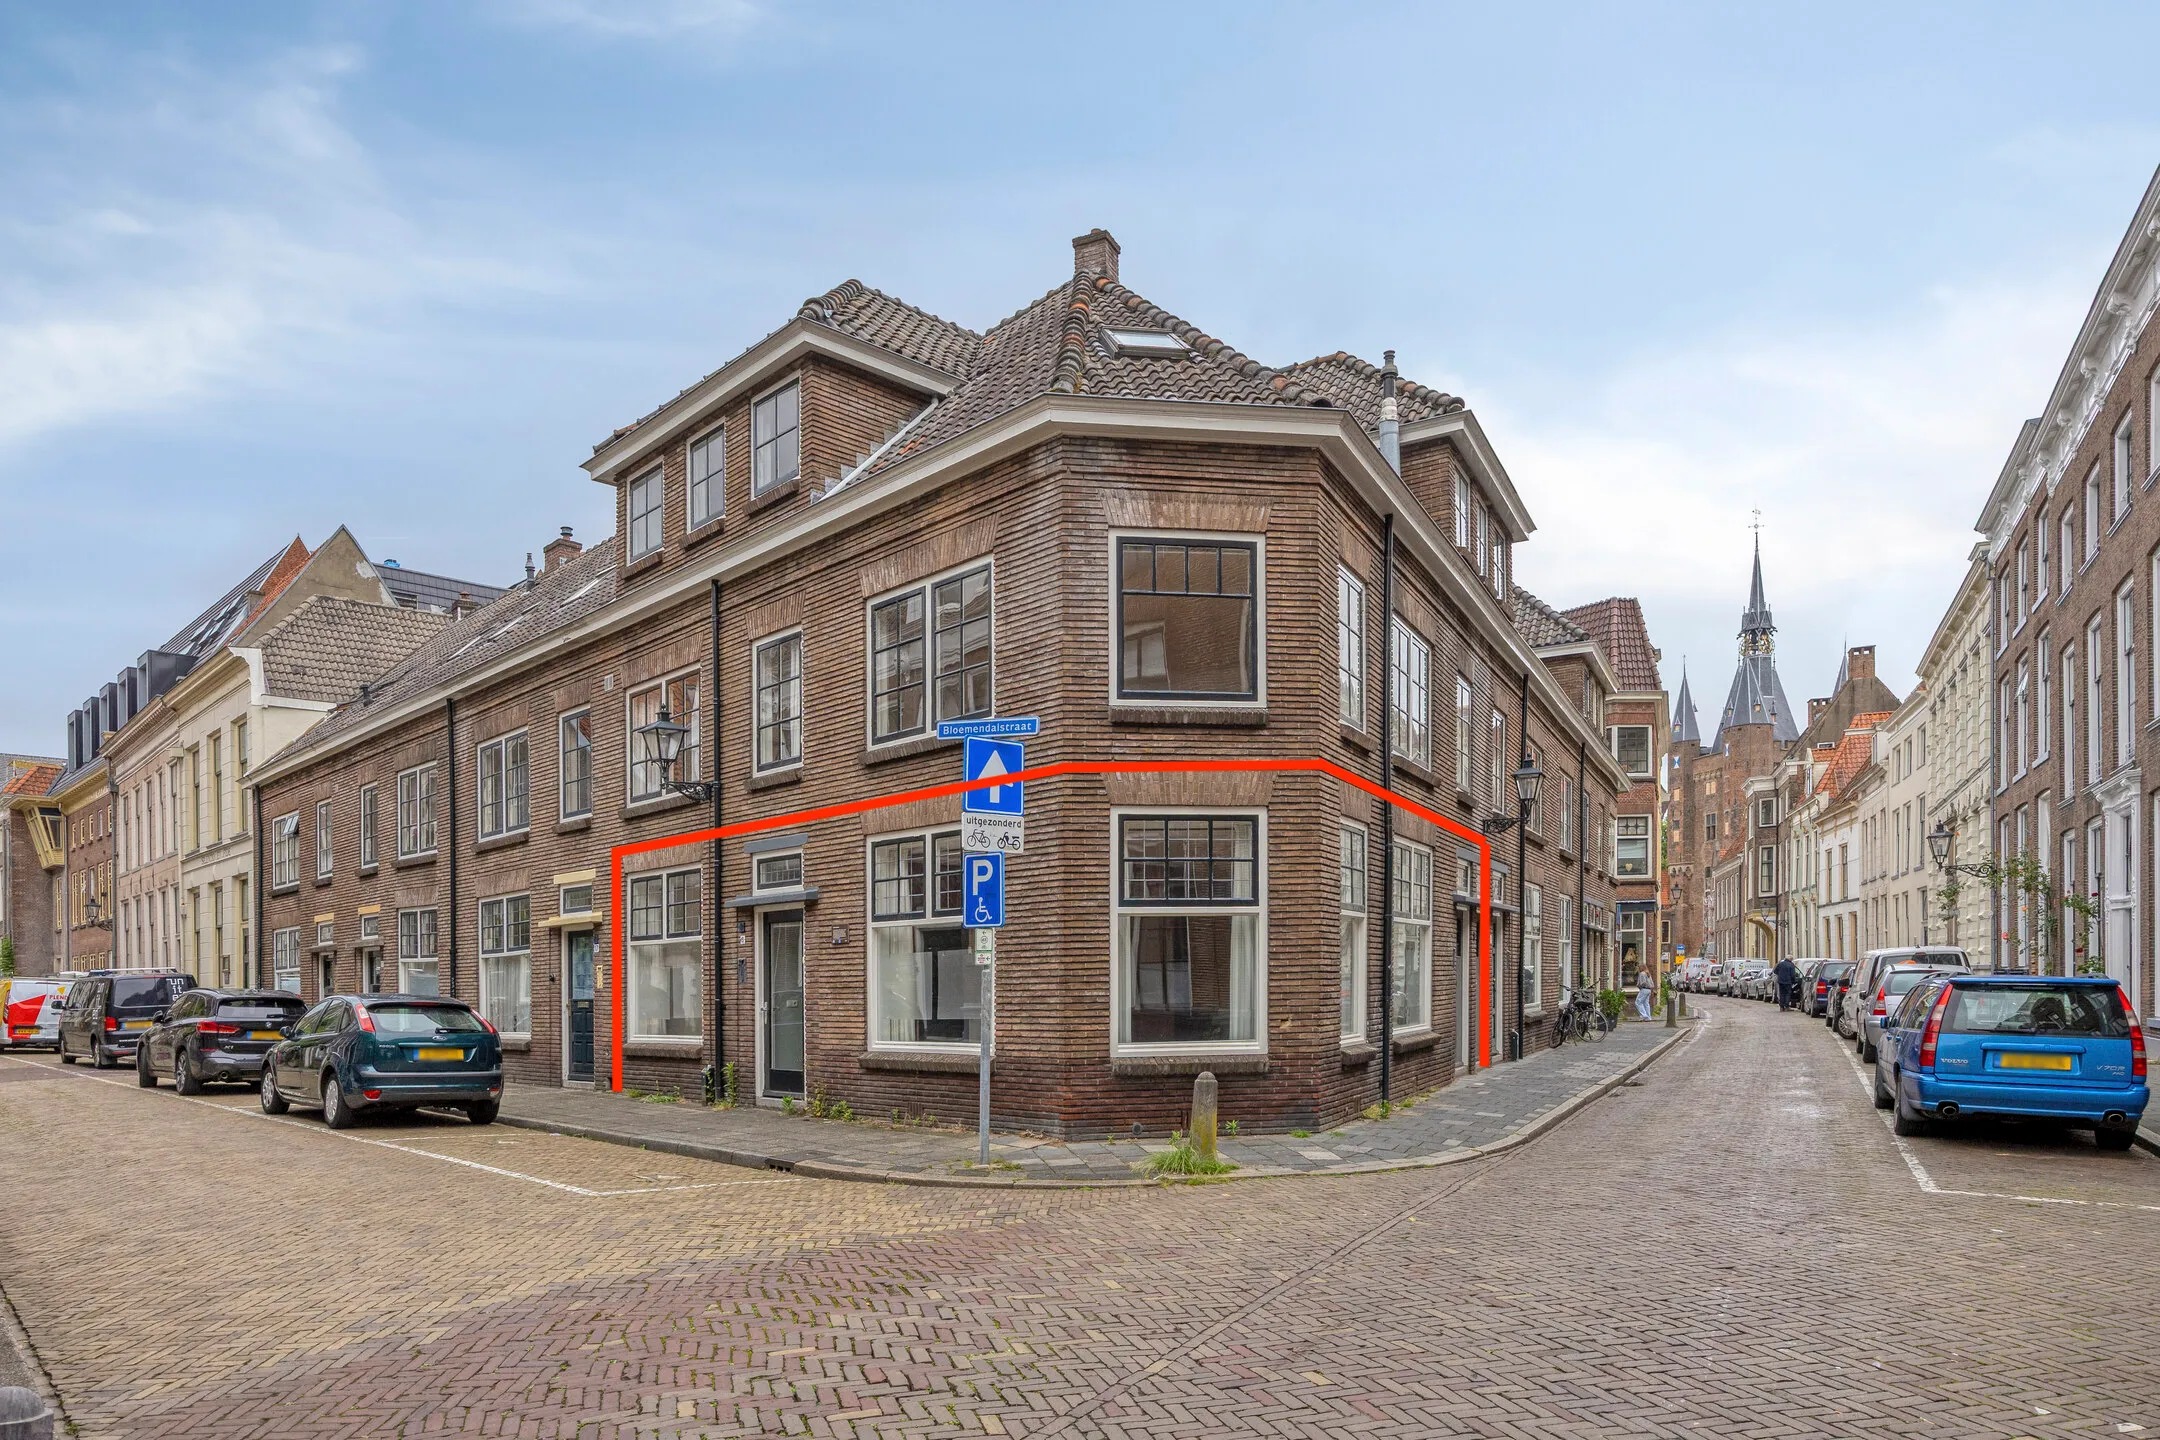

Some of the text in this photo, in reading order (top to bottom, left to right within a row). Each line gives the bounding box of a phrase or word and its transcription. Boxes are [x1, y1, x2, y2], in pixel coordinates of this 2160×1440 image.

[943, 723, 1032, 735] Bloemendalstraat
[966, 816, 1022, 828] uitgezonderd
[972, 859, 993, 896] P
